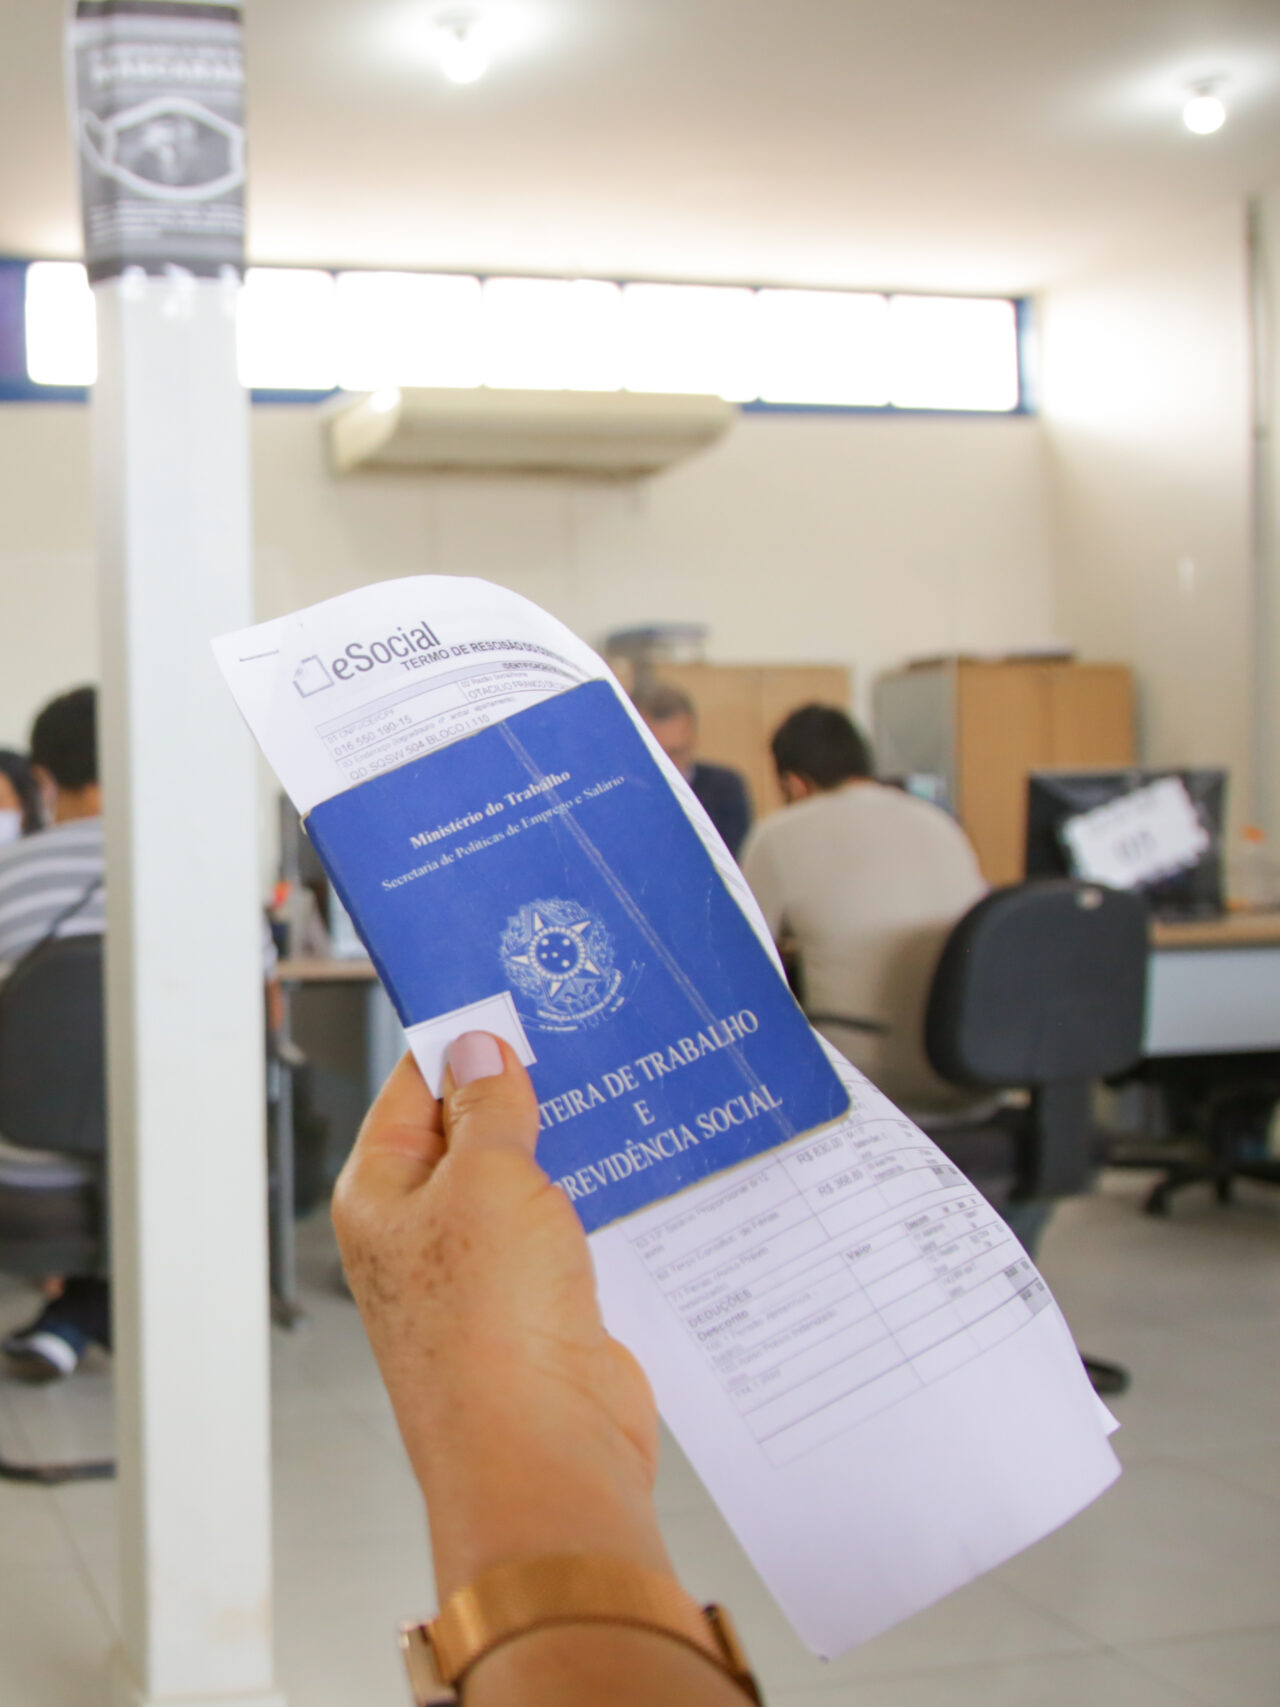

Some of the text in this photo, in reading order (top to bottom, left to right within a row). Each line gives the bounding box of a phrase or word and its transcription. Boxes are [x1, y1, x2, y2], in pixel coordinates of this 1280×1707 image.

[331, 620, 442, 681] eSocial
[400, 648, 450, 672] TERMO
[450, 643, 470, 657] DE
[469, 639, 524, 652] RESCISÃO
[381, 775, 626, 891] Secretaria de Políticas de Emprego e Salário
[409, 771, 571, 850] Ministério do Trabalho
[537, 1008, 759, 1131] TEIRA DE TRABALHO
[552, 1084, 783, 1201] REVIDÊNCIA SOCIAL
[632, 1099, 656, 1126] E
